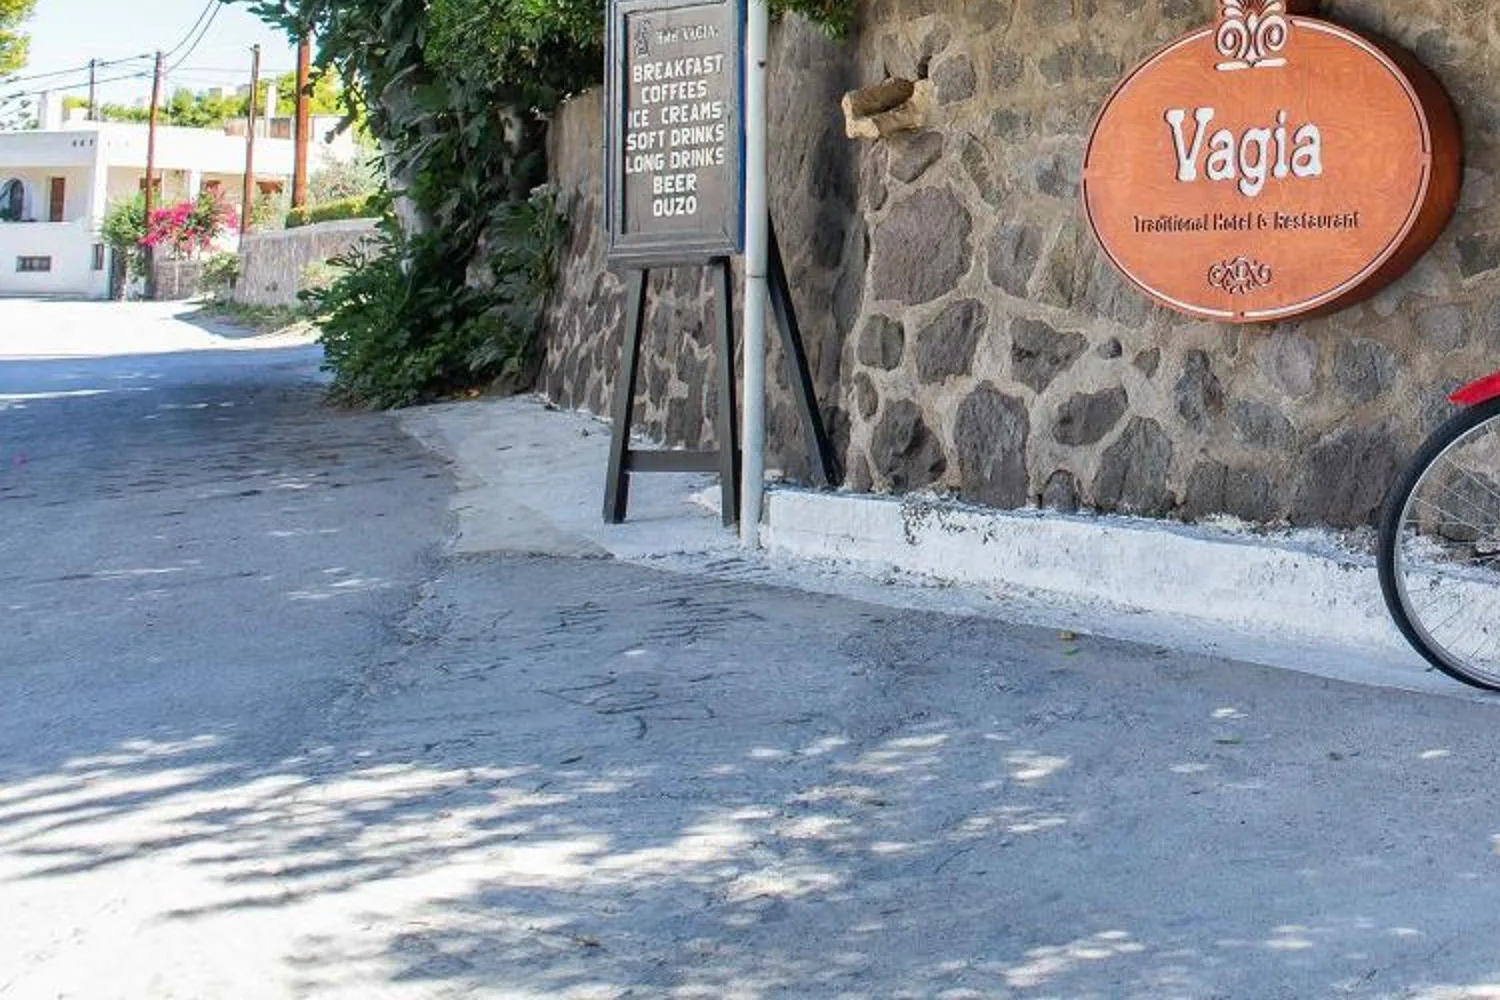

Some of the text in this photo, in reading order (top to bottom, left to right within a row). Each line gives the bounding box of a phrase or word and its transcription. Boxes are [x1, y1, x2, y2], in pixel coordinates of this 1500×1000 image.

[632, 53, 724, 83] BREAKFAST
[641, 80, 708, 105] COFFEES
[627, 101, 722, 129] ICE CREAMS
[626, 123, 725, 151] SOFT DRINKS
[625, 146, 725, 174] LONG DRINKS
[1163, 106, 1323, 197] Vagia
[653, 173, 697, 195] BEER
[653, 196, 697, 217] OUZO
[1133, 210, 1360, 233] Traditional Hotel & Restaurant
